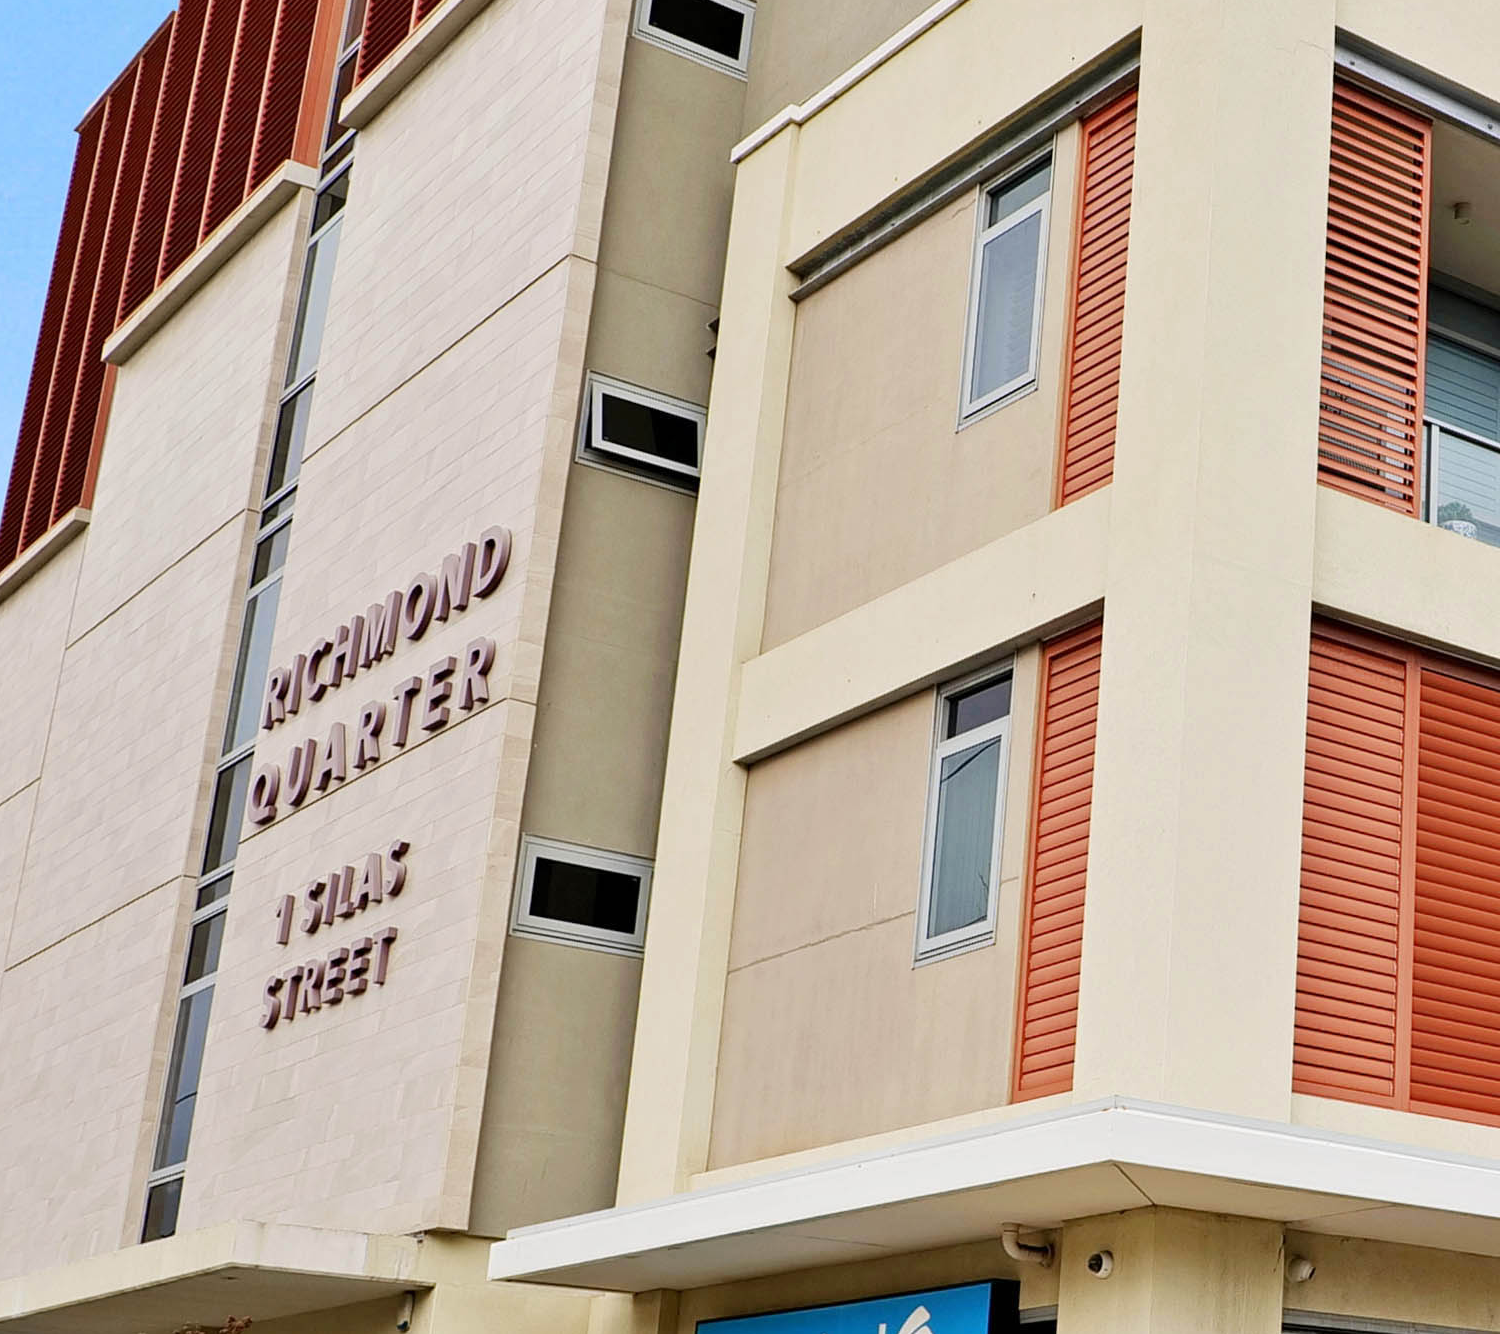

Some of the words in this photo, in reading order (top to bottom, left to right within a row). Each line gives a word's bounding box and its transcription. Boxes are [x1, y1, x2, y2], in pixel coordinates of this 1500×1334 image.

[262, 525, 512, 730] RICHMOND
[247, 637, 496, 825] QUARTER
[275, 893, 295, 945] 1
[301, 840, 410, 935] SILAS
[259, 926, 398, 1030] STREET
